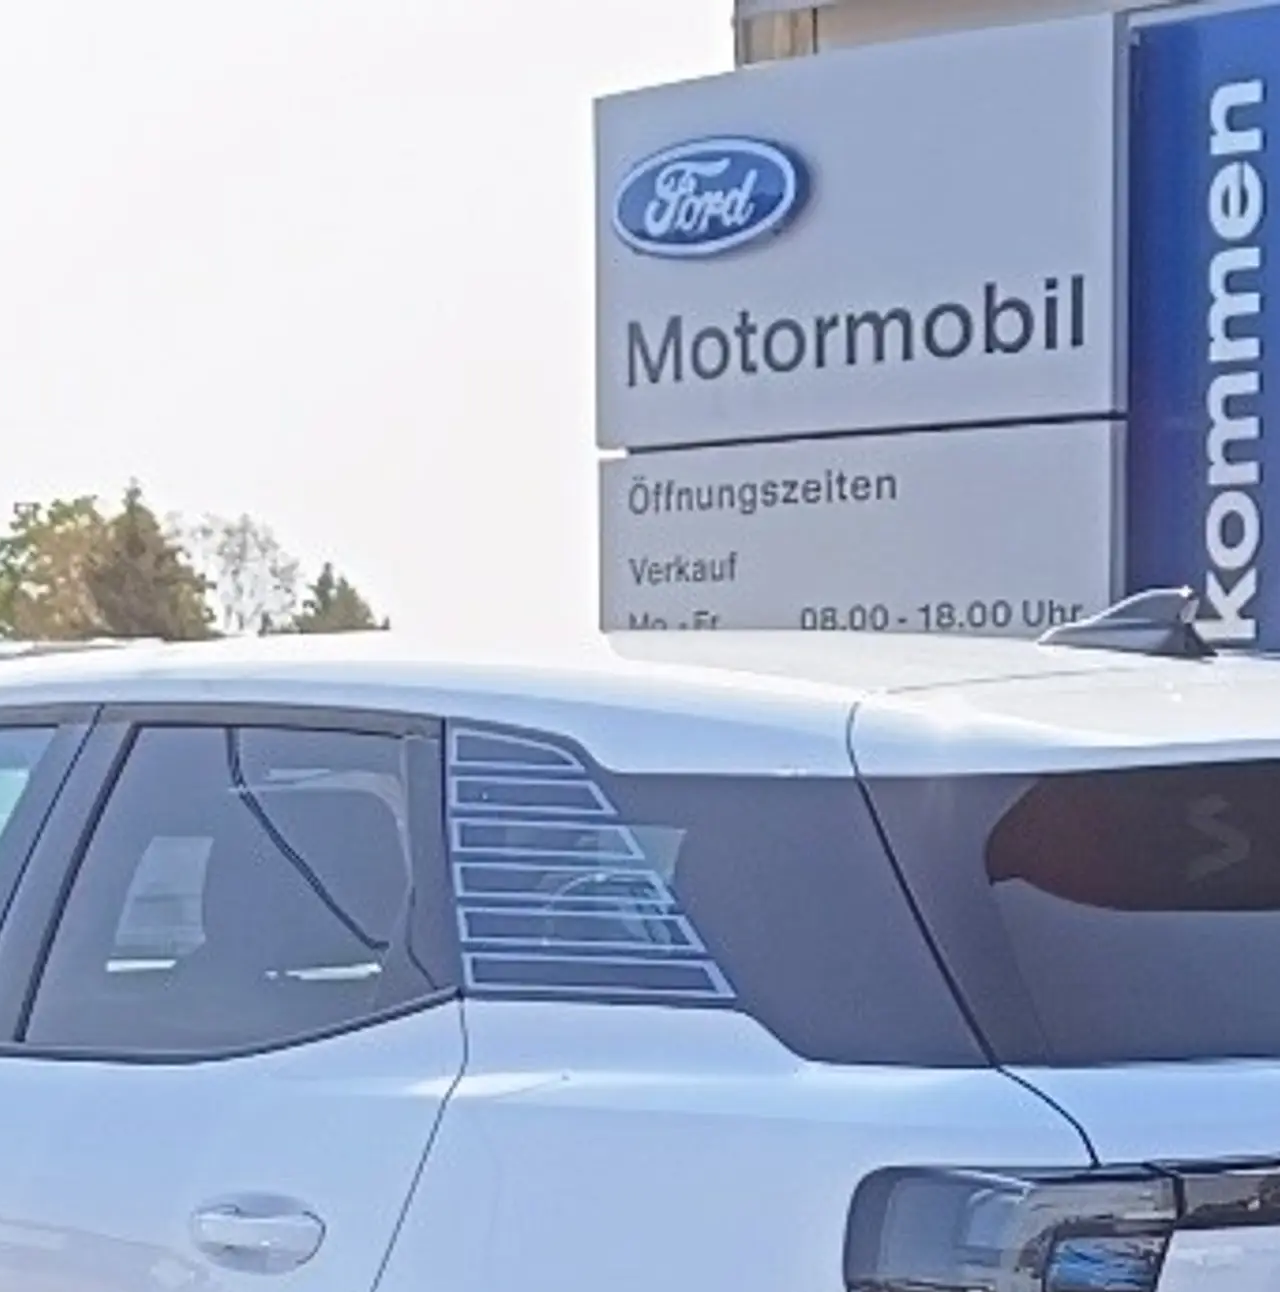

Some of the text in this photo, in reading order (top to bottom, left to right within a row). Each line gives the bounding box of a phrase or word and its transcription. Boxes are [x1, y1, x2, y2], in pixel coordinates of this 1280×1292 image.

[643, 157, 758, 238] Ford
[627, 274, 1085, 387] Motormobil
[1205, 79, 1265, 641] kommen
[628, 469, 898, 515] Öffnungszeiten
[628, 551, 738, 585] Verkauf
[800, 604, 889, 631] 08.00
[917, 599, 1013, 629] 18.00
[1022, 599, 1084, 622] Uhr
